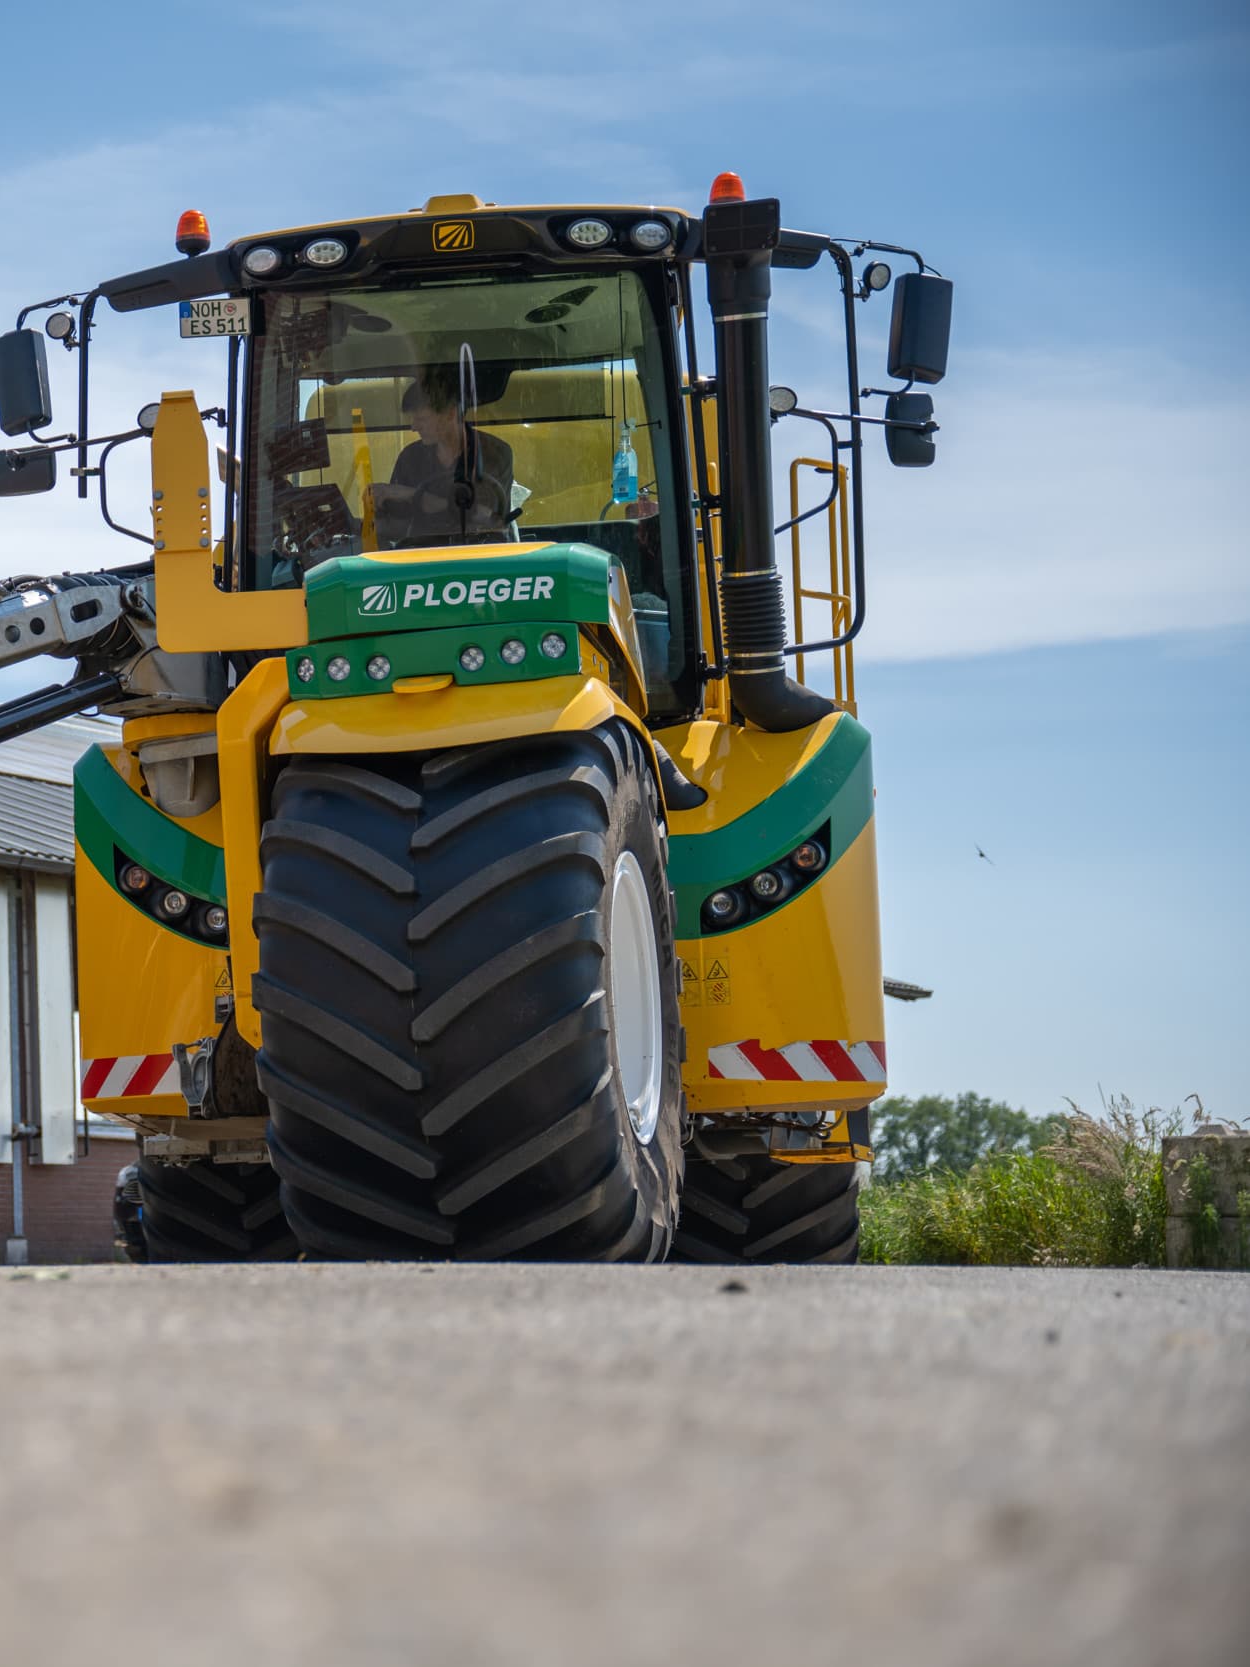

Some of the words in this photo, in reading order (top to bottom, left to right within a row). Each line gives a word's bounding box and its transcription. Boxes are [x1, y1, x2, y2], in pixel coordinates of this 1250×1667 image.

[191, 303, 221, 318] NOH
[191, 319, 212, 335] ES
[217, 318, 248, 334] 511
[403, 576, 556, 608] PLOEGER
[651, 857, 672, 969] MEGA
